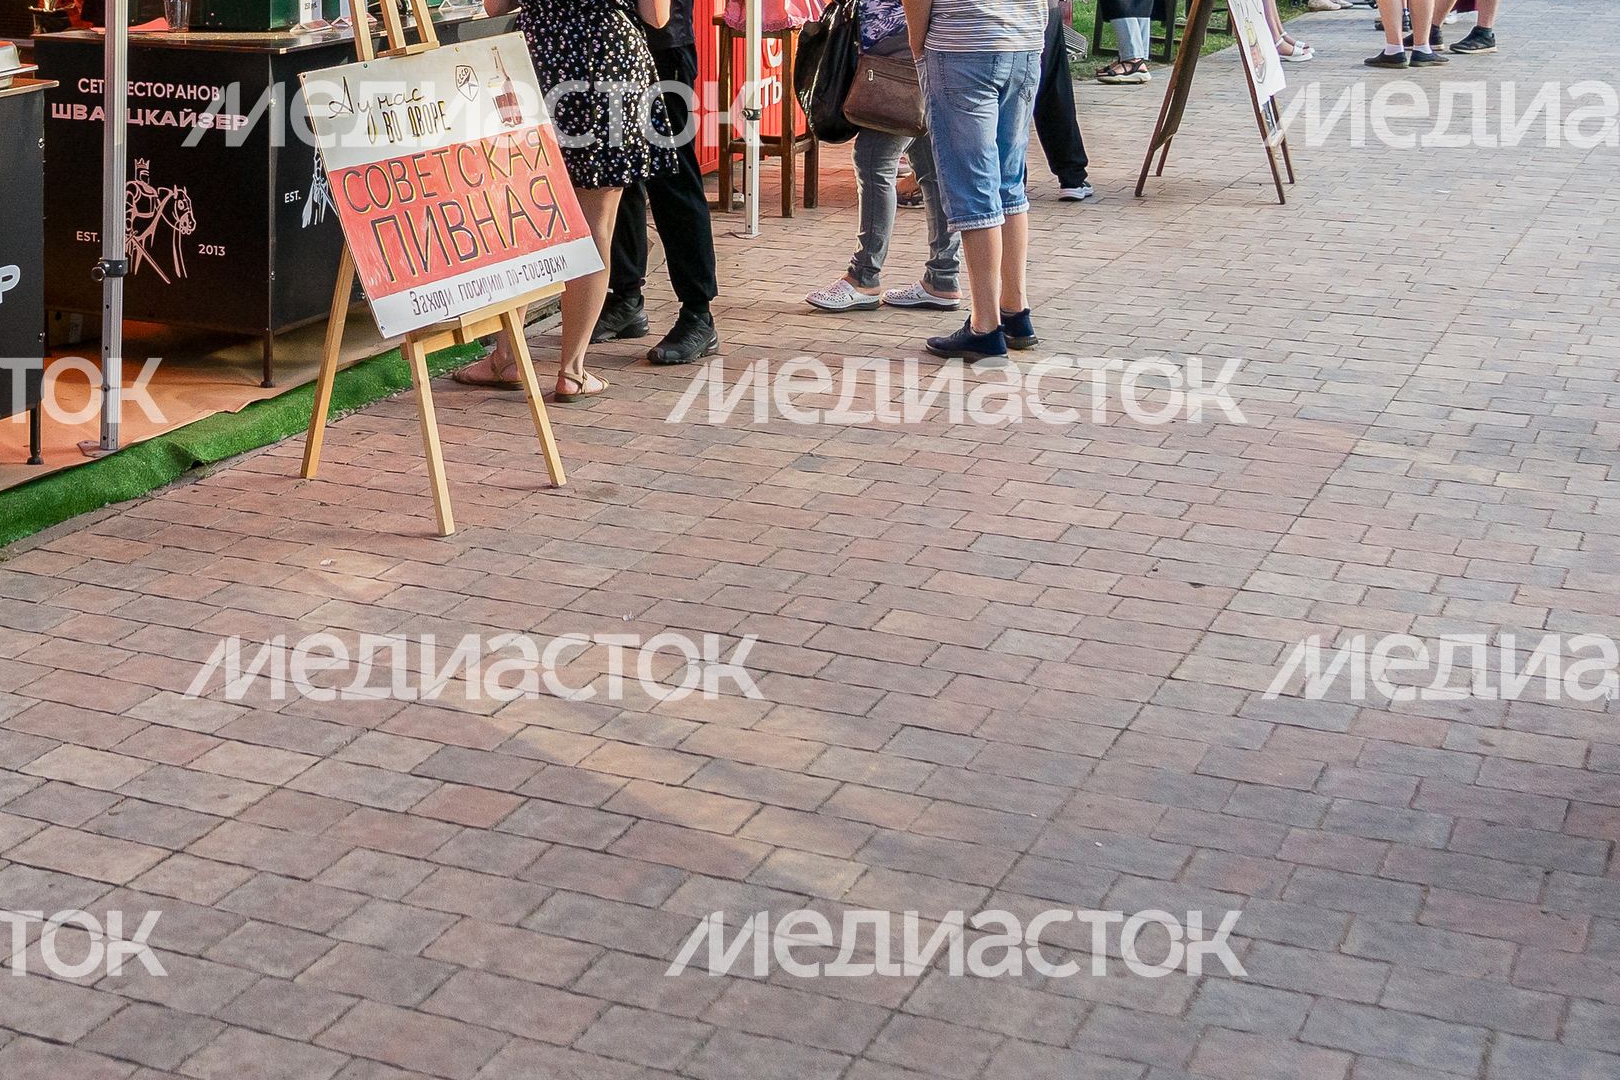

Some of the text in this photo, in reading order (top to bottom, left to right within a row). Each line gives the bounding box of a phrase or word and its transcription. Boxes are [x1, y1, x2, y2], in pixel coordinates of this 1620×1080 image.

[77, 77, 221, 102] СЕТ ЕСТОРАНОВ
[51, 102, 249, 131] ШВАЦКАЙЗЕР
[342, 129, 551, 214] СОВЕТСКАЯ
[284, 190, 302, 203] EST.
[370, 175, 571, 283] ПИВНАЯ
[76, 230, 226, 257] EST. 2013
